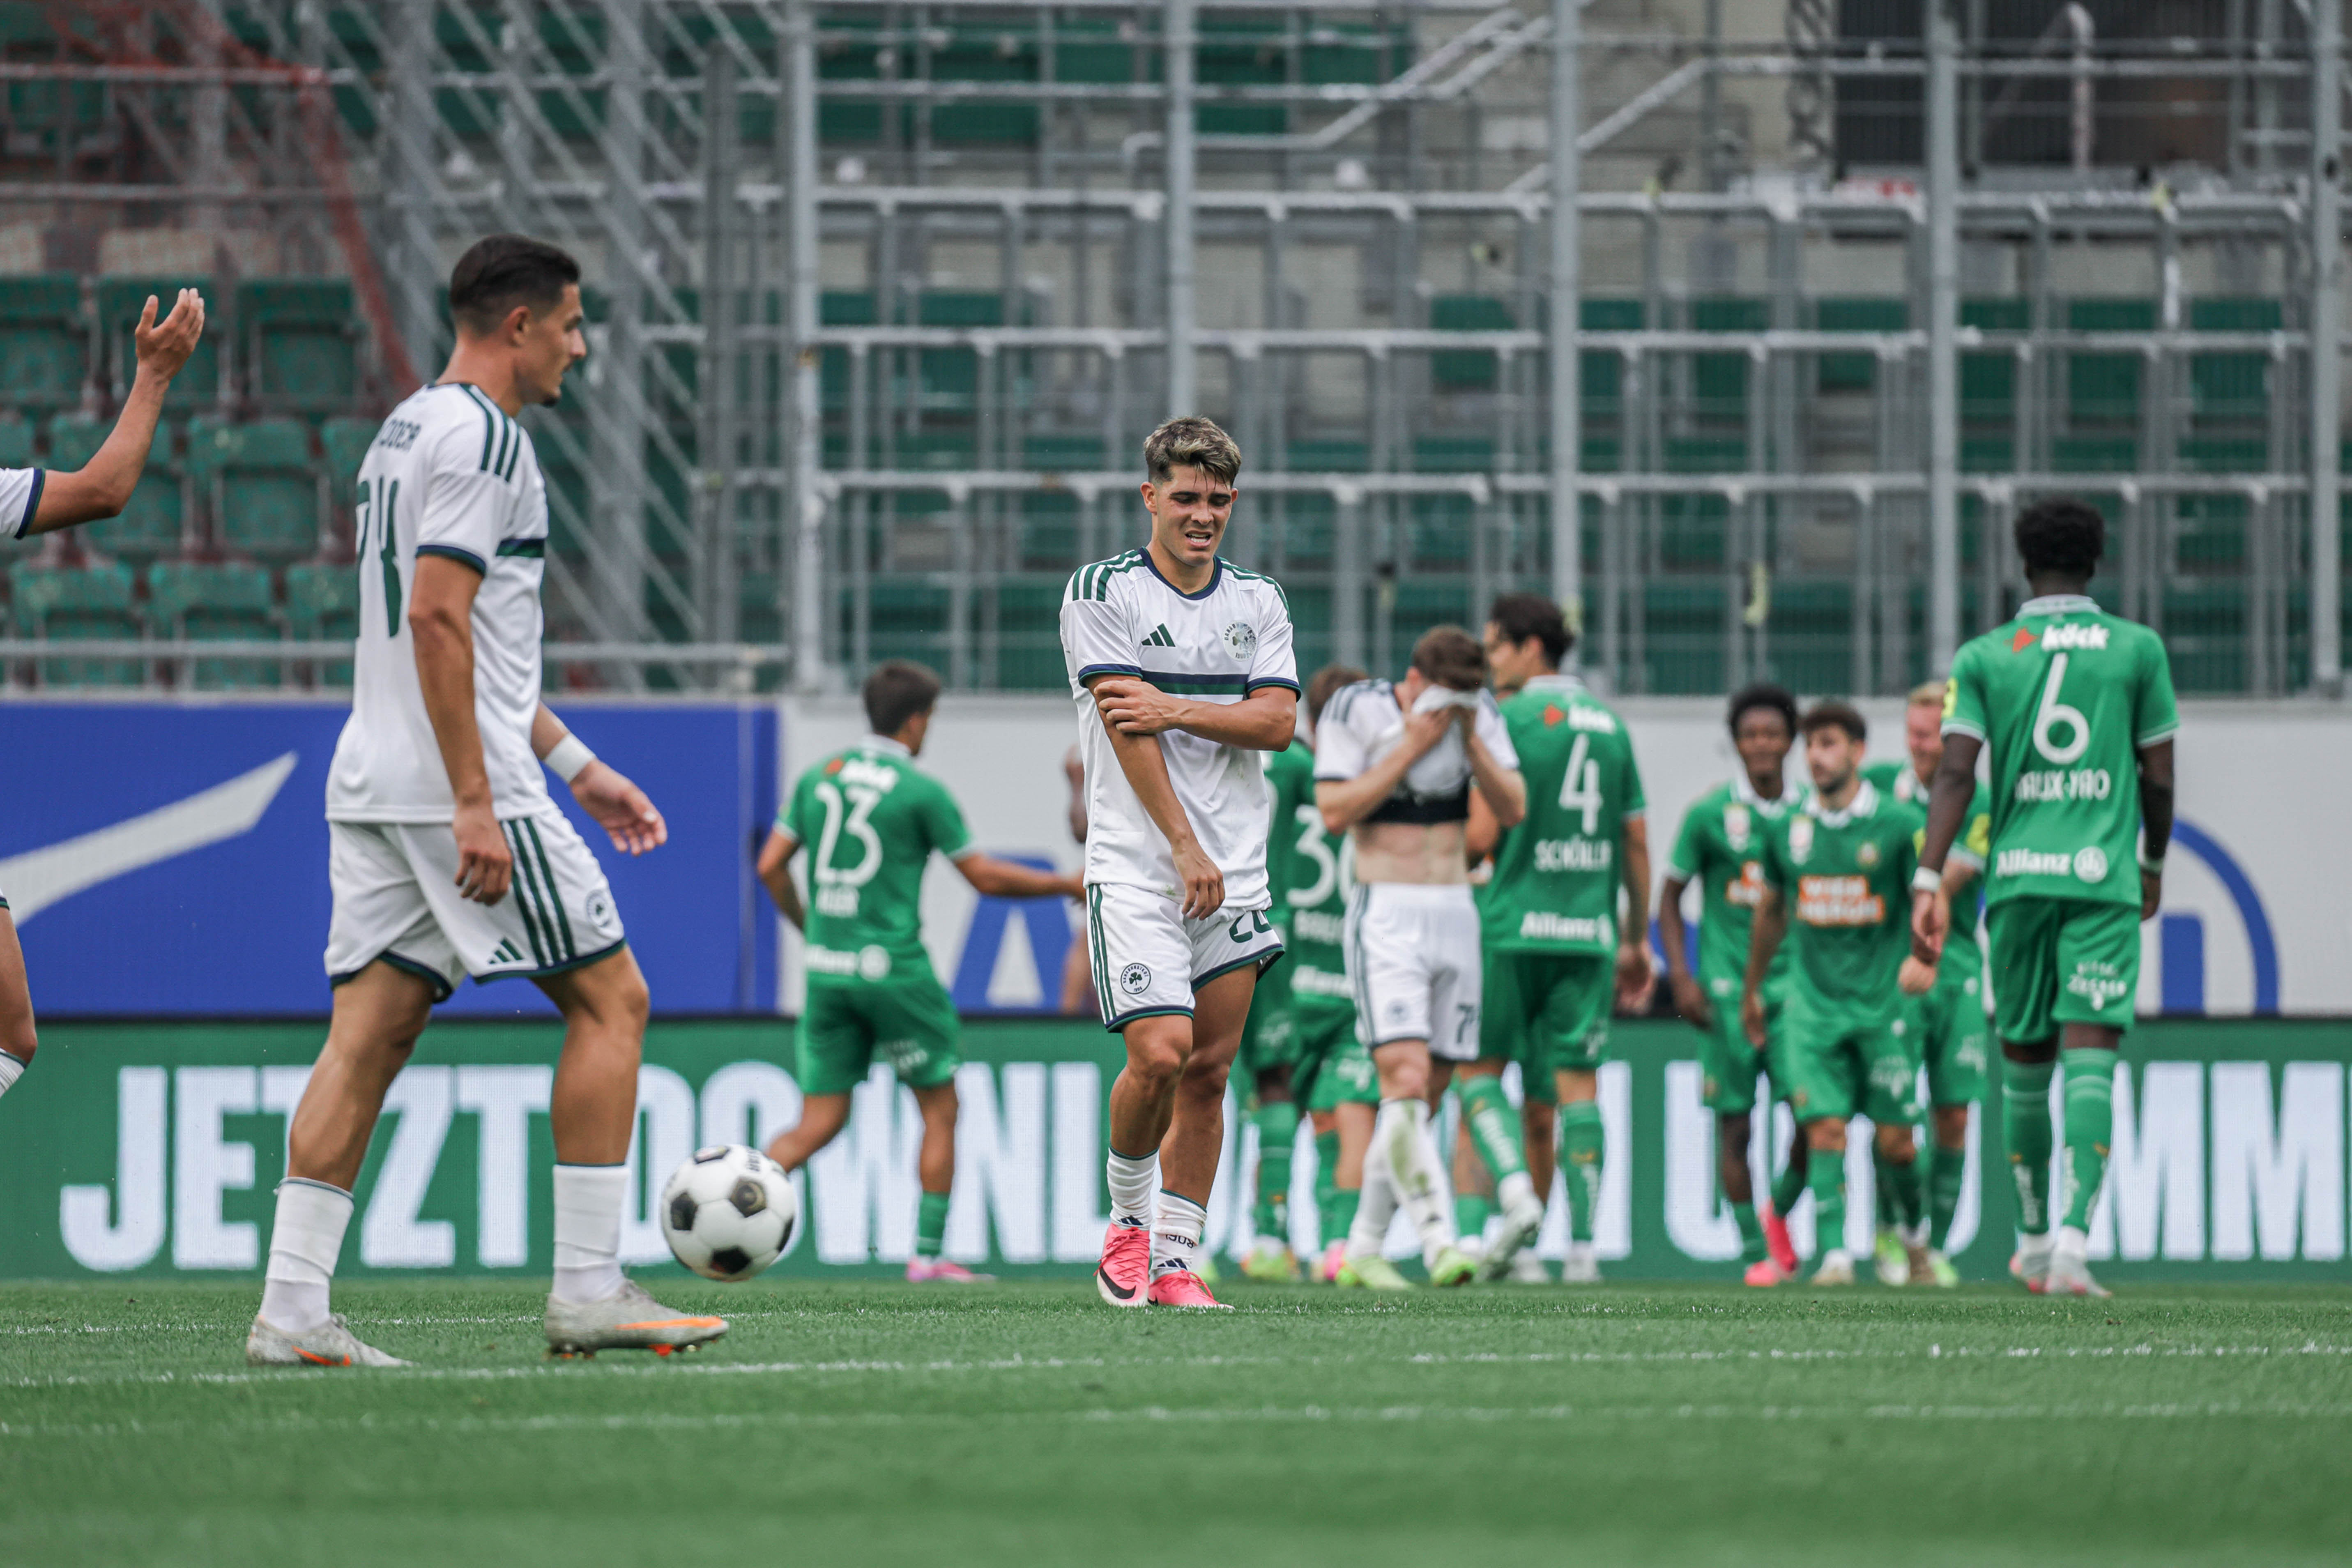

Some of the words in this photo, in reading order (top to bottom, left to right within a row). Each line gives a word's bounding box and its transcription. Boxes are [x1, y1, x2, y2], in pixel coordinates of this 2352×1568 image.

[2033, 652, 2090, 764] 6
[814, 781, 883, 888] 23
[1559, 733, 1603, 836] 4
[1995, 847, 2071, 878] Allianz
[60, 1065, 553, 1272] JEZT
